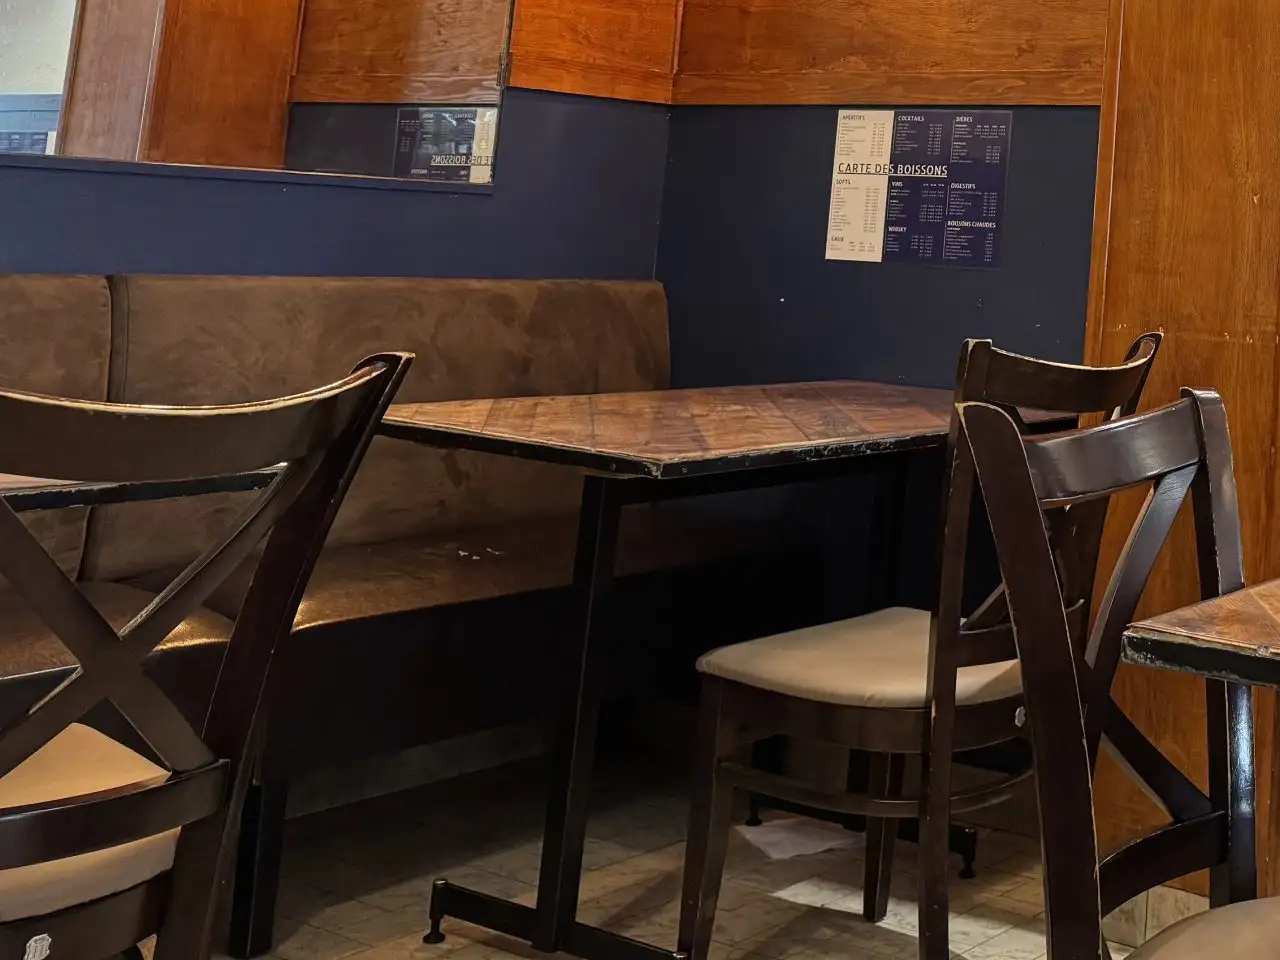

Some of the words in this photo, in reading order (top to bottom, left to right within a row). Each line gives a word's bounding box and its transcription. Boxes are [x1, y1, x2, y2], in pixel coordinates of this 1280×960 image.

[838, 162, 871, 174] CARTE
[874, 163, 894, 175] DES
[897, 164, 948, 176] BOISSONS
[951, 182, 976, 190] DIGESTIFS
[947, 220, 972, 228] BOISSONS
[972, 221, 996, 229] CHAUDES
